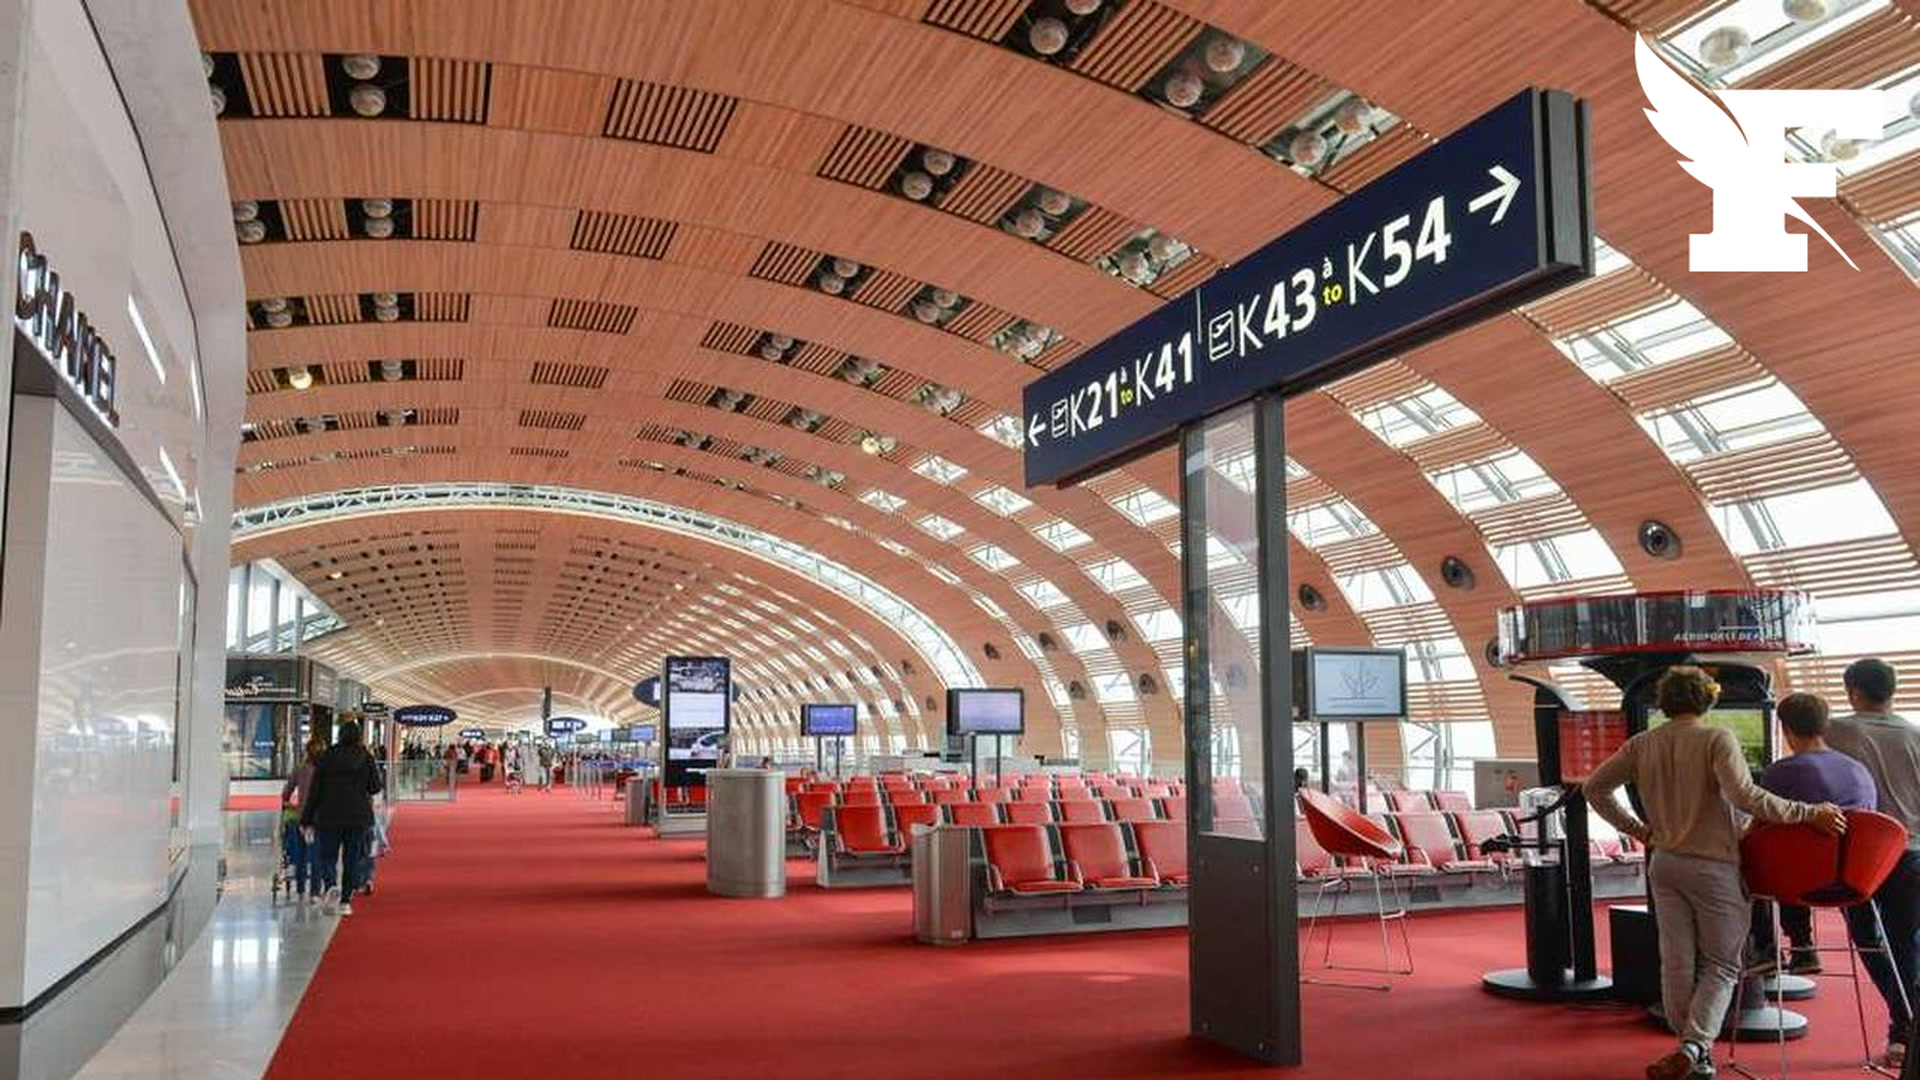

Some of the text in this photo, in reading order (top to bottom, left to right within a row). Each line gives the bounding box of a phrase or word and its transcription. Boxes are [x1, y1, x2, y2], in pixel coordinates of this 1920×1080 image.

[16, 231, 119, 428] CHANEL
[1239, 195, 1452, 357] K43 à to K54
[1070, 371, 1118, 437] K21
[1120, 388, 1133, 405] to
[1135, 331, 1193, 406] K41
